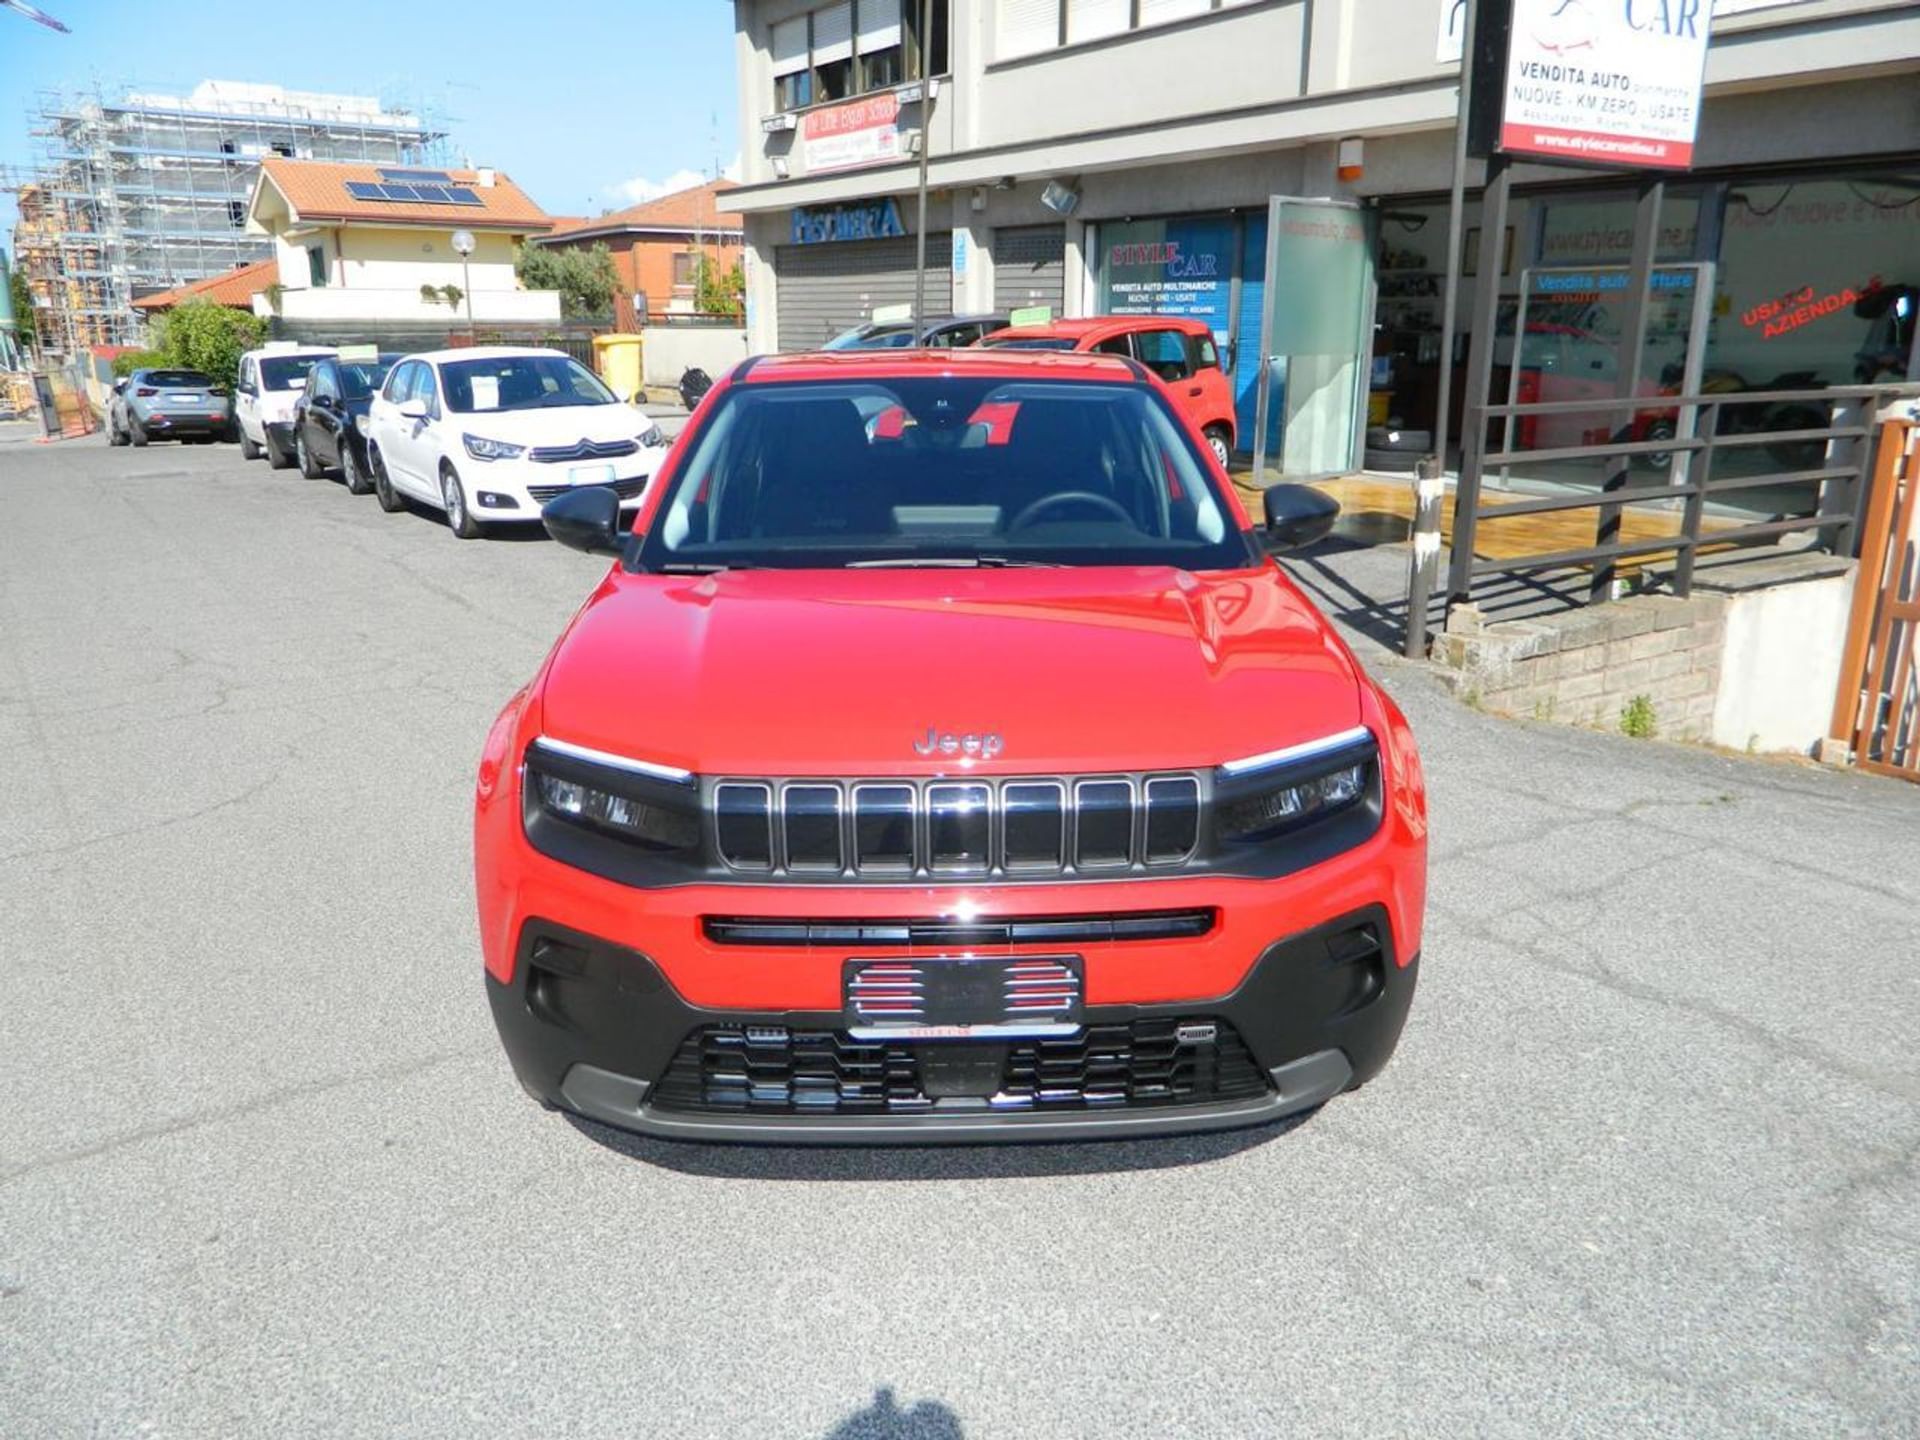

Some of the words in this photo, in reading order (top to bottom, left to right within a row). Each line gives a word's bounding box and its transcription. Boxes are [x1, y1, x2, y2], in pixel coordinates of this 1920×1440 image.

[1624, 0, 1699, 39] CAR
[1518, 60, 1585, 85] VENDITA
[1590, 71, 1631, 92] AUTO
[1513, 85, 1563, 107] NUOVE
[1576, 94, 1598, 110] KM
[1600, 96, 1637, 117] ZERO
[1650, 104, 1691, 123] USATE
[1111, 241, 1179, 267] STYLE
[1167, 253, 1218, 277] CAR
[1111, 283, 1141, 293] VENDITA
[1143, 282, 1162, 292] AUTO
[1536, 274, 1594, 291] Vendita
[912, 727, 1004, 759] Jeep
